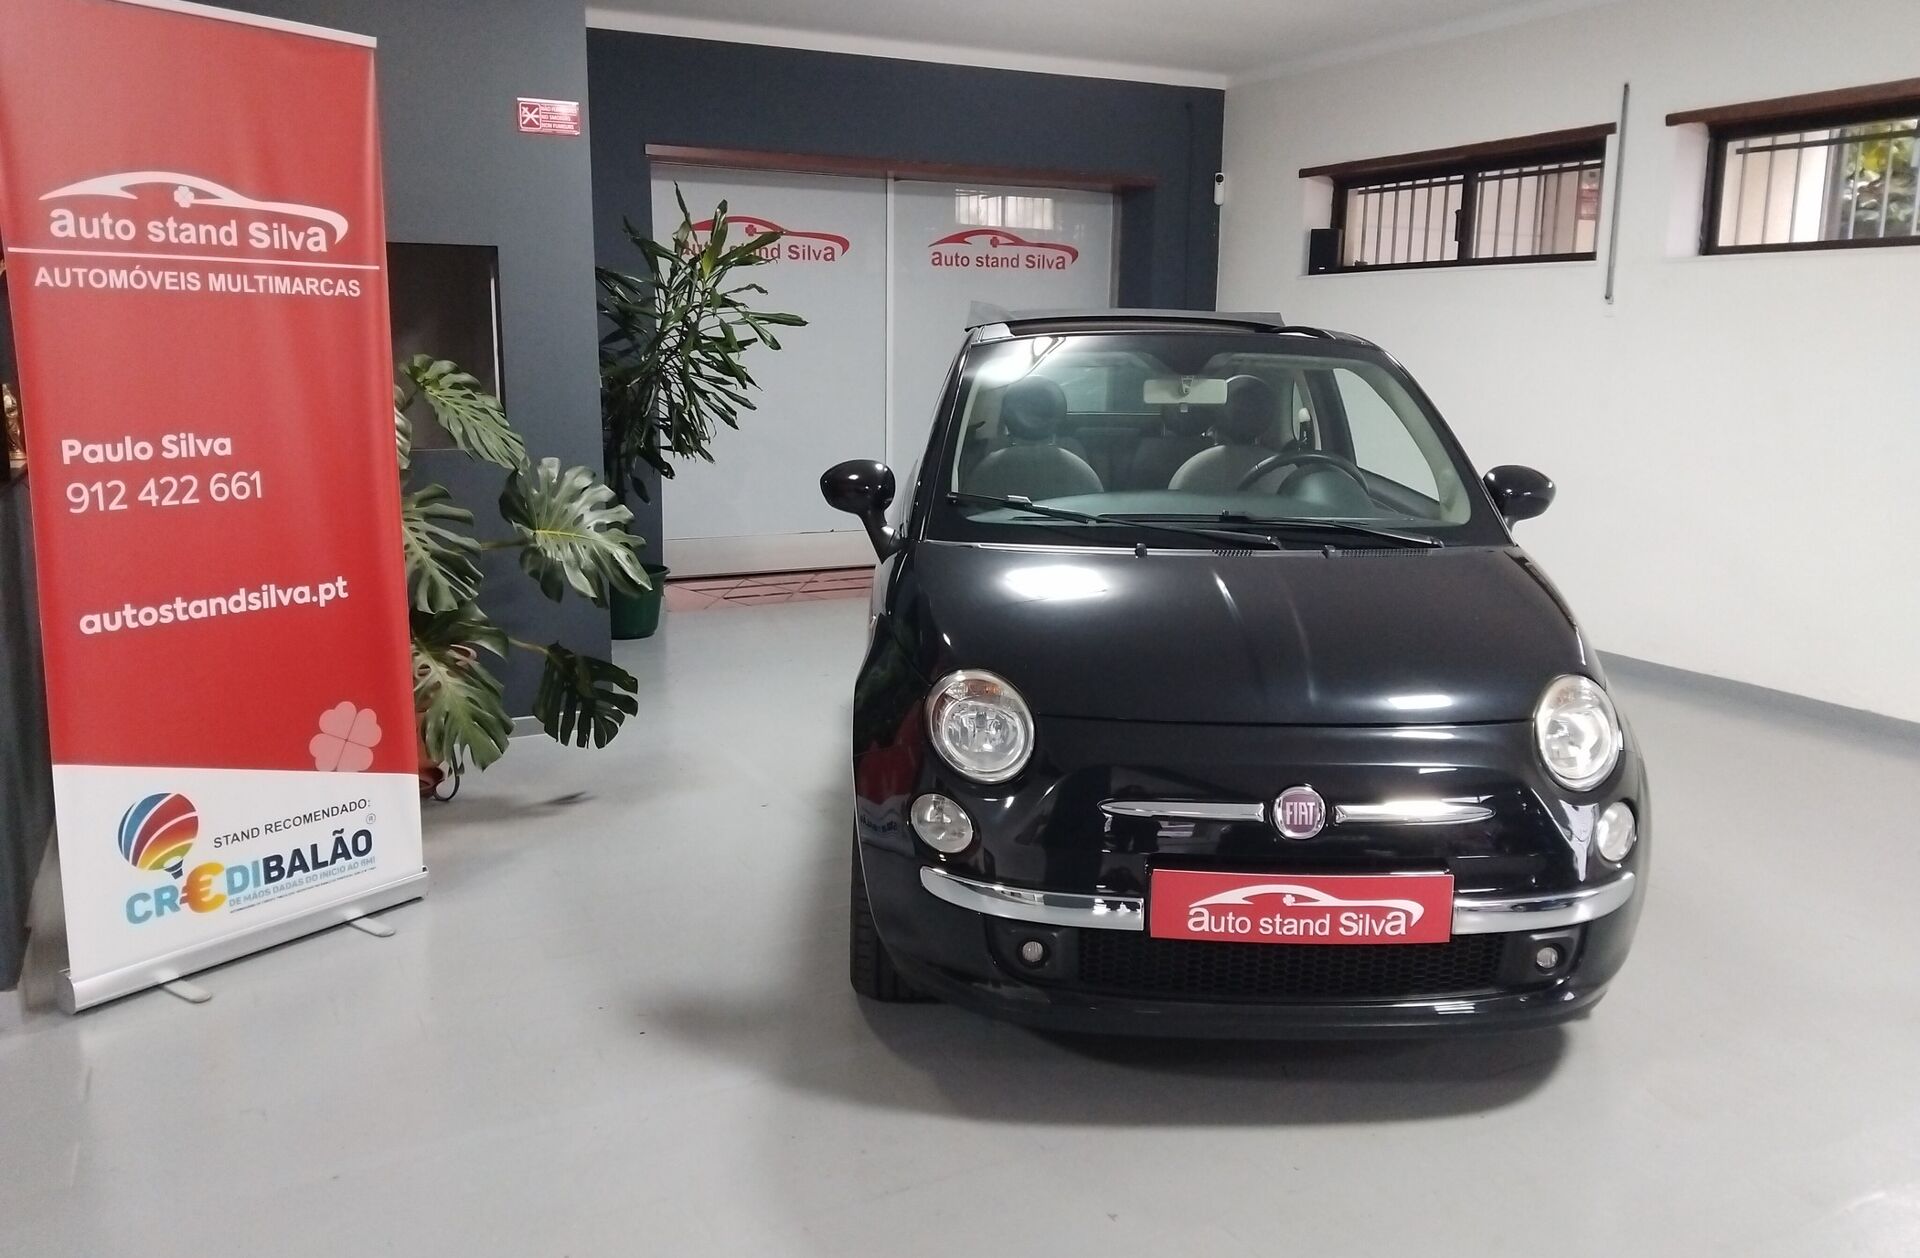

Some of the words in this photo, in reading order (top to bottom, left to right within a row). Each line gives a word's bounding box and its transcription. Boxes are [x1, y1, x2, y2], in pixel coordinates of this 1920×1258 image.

[50, 207, 136, 241] auto
[147, 217, 238, 247] stand
[248, 221, 328, 253] Silva
[787, 242, 836, 262] Silva
[931, 251, 970, 268] auto
[975, 253, 1020, 269] stand
[1025, 254, 1066, 270] Silva
[34, 265, 201, 292] AUTOMÓVEIS
[208, 272, 361, 298] MULTIMARCAS
[61, 435, 154, 465] Paulo
[161, 432, 232, 460] Silva
[65, 480, 128, 514] 912
[138, 474, 200, 507] 422
[209, 470, 263, 502] 661
[79, 575, 349, 635] autostandsilva.pt
[213, 827, 261, 849] STAND
[264, 798, 371, 836] RECOMENDADO:
[1285, 801, 1316, 826] FIAT
[229, 896, 241, 907] DE
[1187, 907, 1252, 934] auto
[1259, 912, 1330, 936] stand
[1338, 911, 1406, 936] Silva
